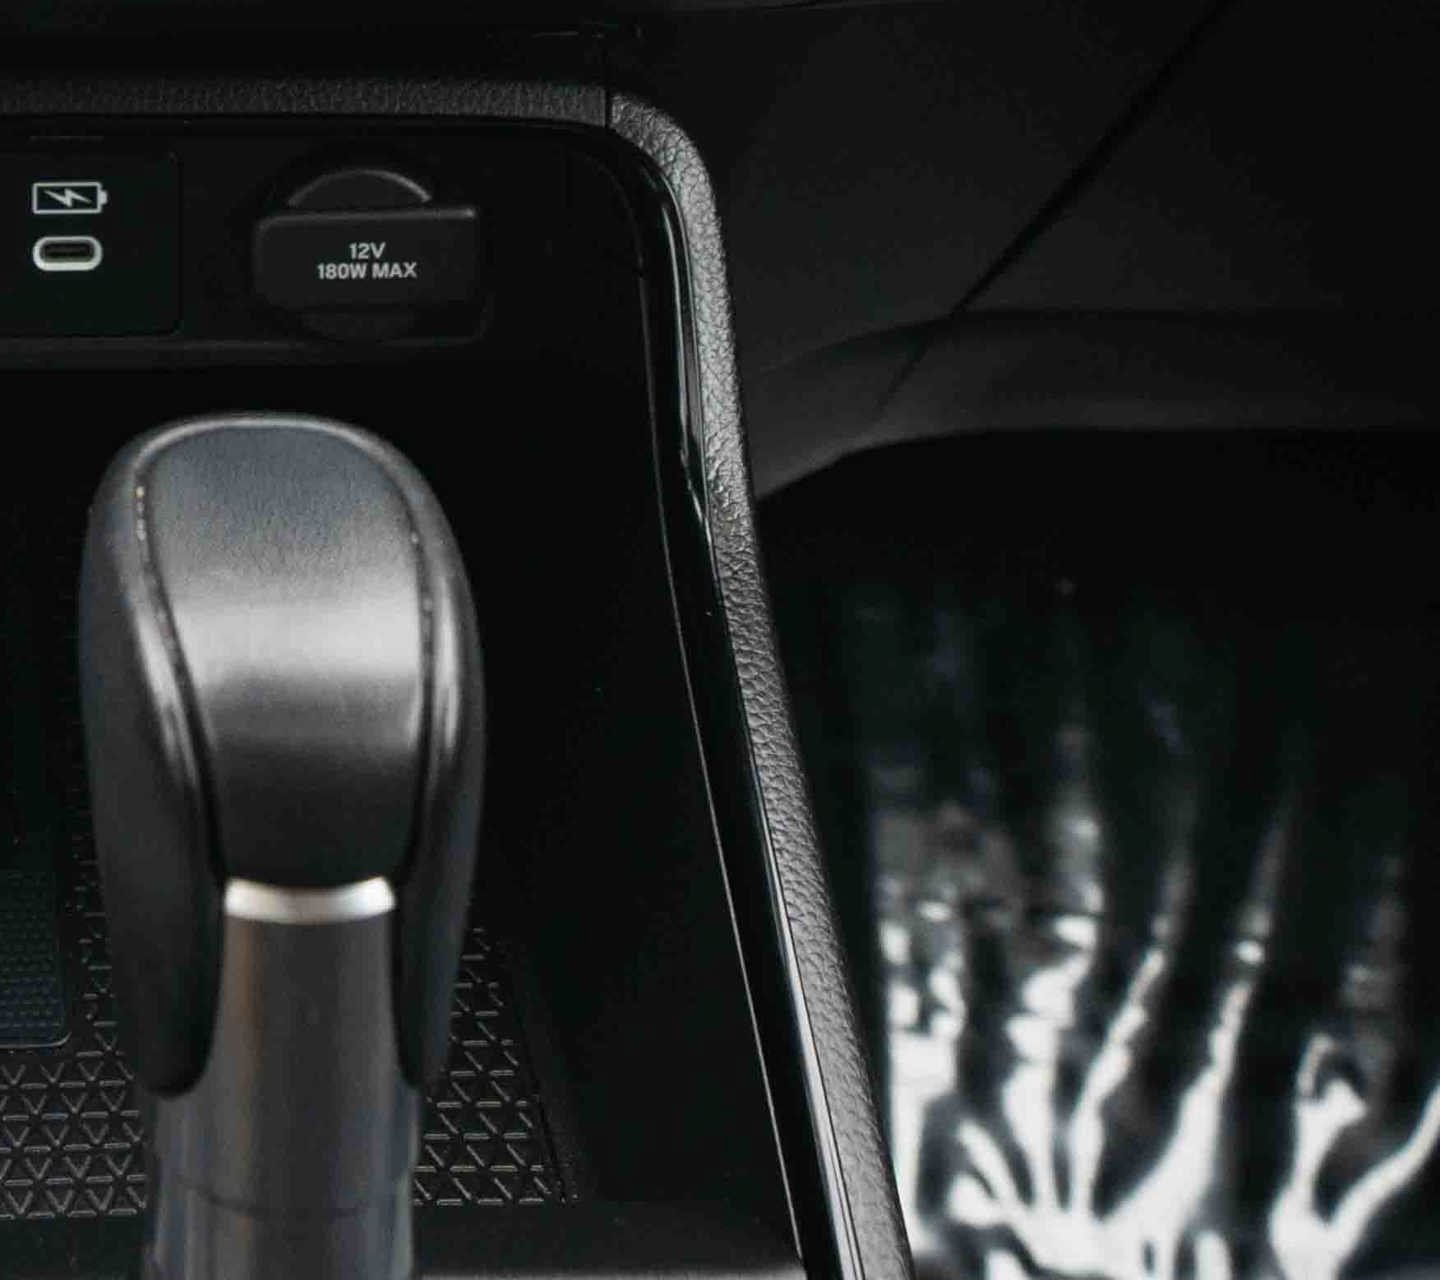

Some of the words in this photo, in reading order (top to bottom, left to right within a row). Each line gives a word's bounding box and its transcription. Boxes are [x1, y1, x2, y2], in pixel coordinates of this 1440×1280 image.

[349, 242, 386, 260] 12V
[317, 262, 367, 280] 180W
[372, 262, 417, 279] MAX
